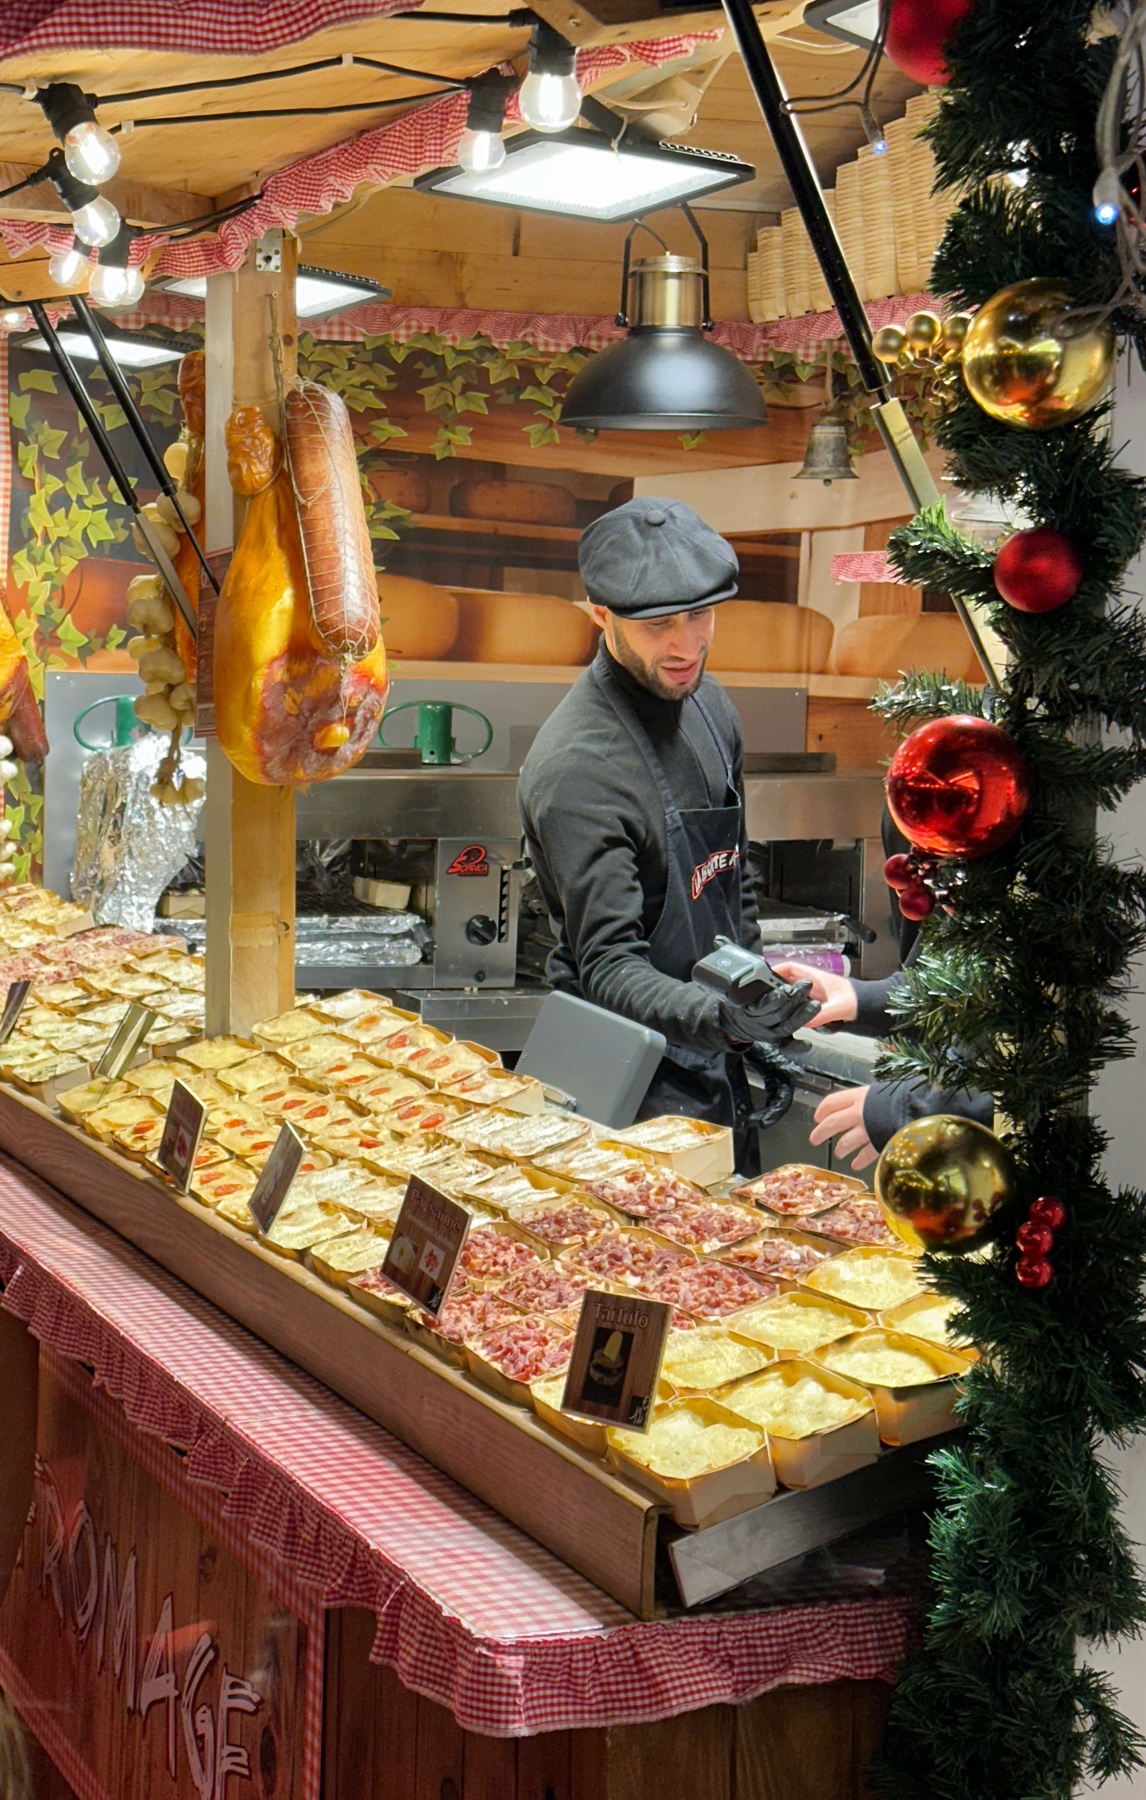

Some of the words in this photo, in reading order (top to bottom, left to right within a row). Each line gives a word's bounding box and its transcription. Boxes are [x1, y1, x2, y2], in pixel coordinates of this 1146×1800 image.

[410, 1187, 461, 1235] Paysanne
[593, 1301, 649, 1330] Tartufo
[22, 1453, 261, 1800] ROMAGE
